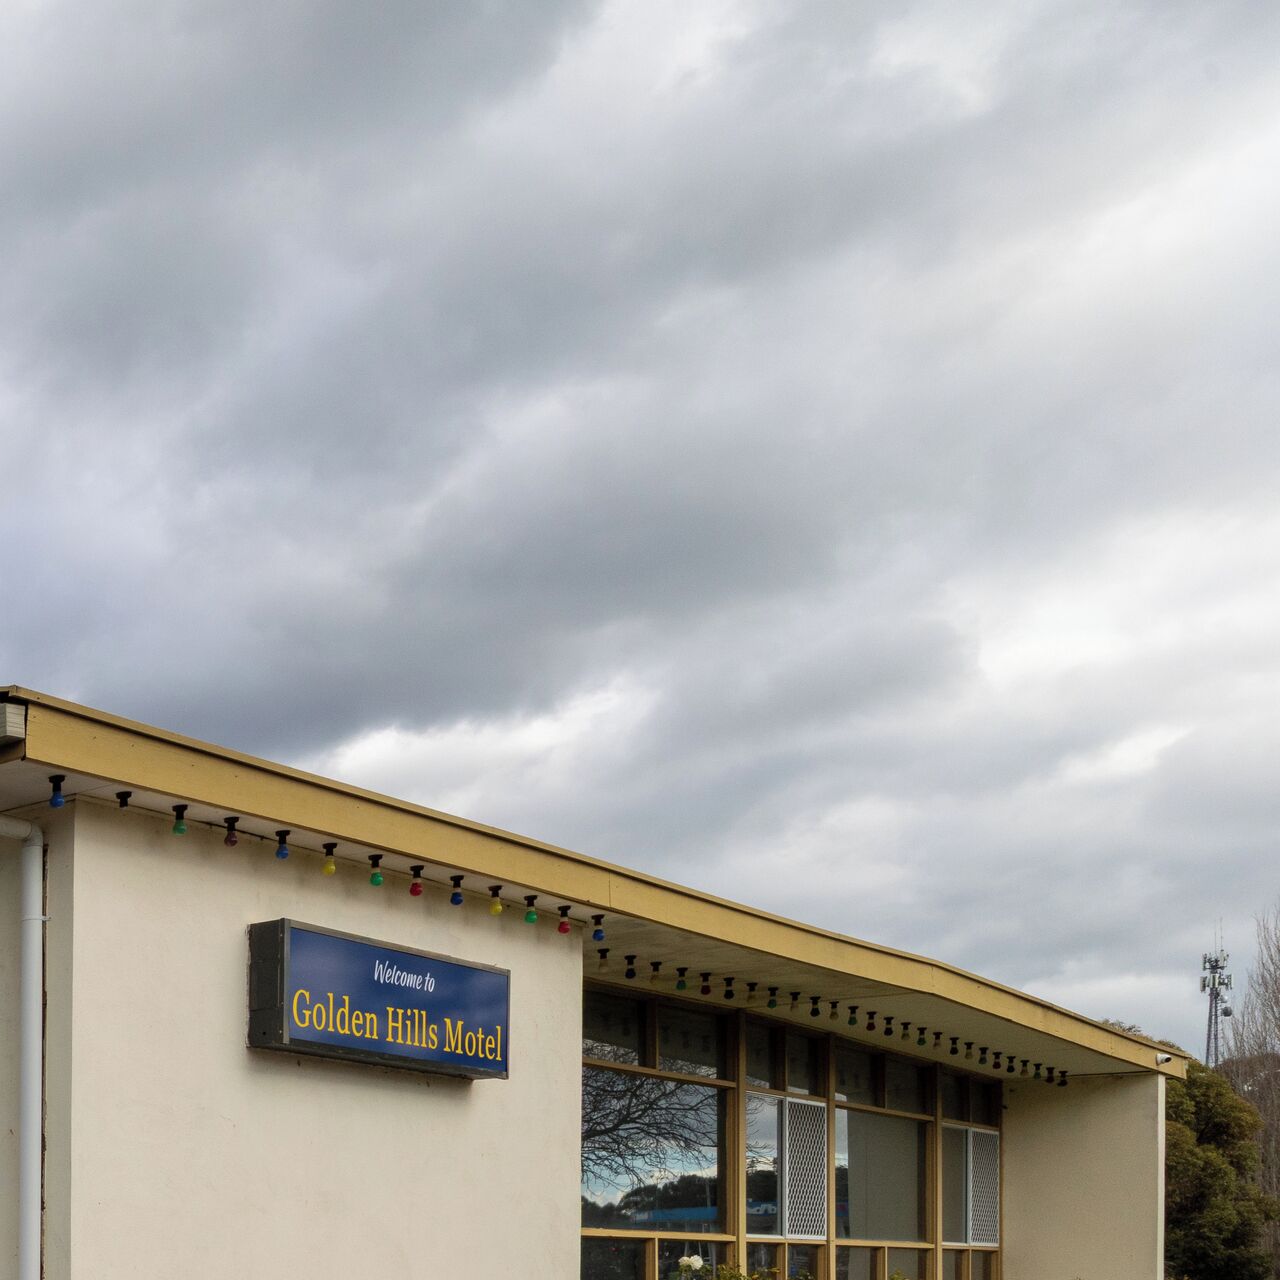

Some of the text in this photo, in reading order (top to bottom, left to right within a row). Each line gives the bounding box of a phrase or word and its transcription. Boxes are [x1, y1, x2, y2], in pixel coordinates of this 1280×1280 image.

[374, 959, 435, 992] Welcome to
[292, 989, 503, 1061] Golden Hills Motel
